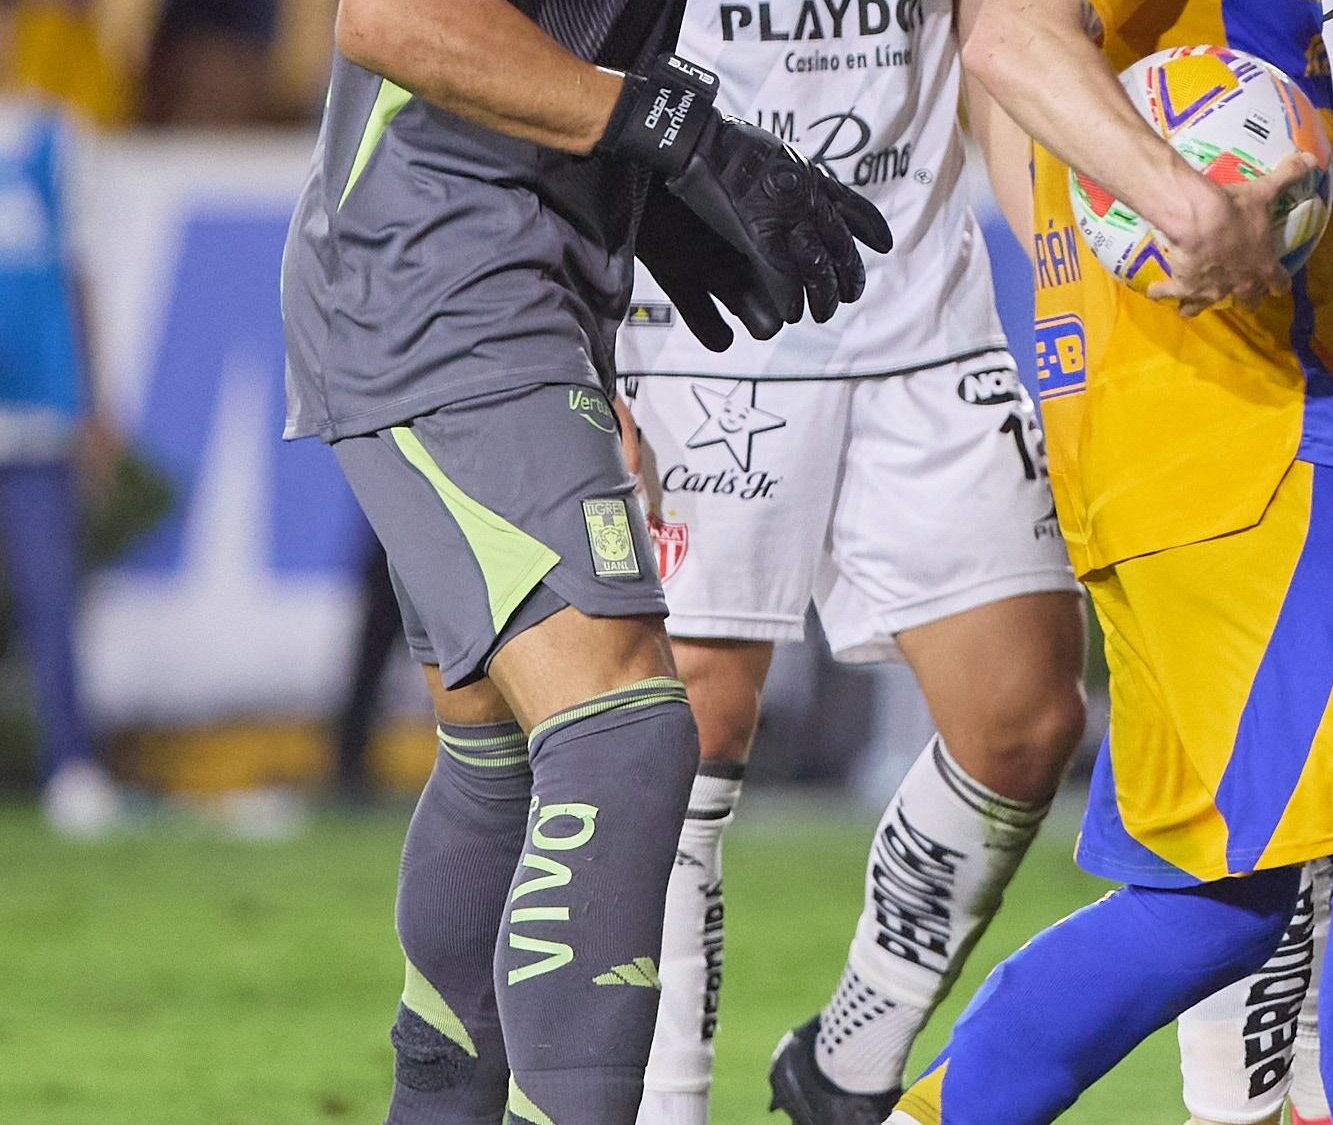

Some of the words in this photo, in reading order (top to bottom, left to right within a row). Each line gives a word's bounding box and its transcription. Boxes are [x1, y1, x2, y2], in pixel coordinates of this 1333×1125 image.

[784, 50, 840, 74] Casino
[846, 52, 868, 70] en
[644, 87, 672, 130] VERO
[658, 89, 696, 149] NAHUEL
[664, 107, 677, 119] Y
[661, 463, 737, 494] Carl's
[739, 470, 779, 500] Jr.
[584, 499, 627, 517] TIGRES
[602, 560, 631, 573] UANL
